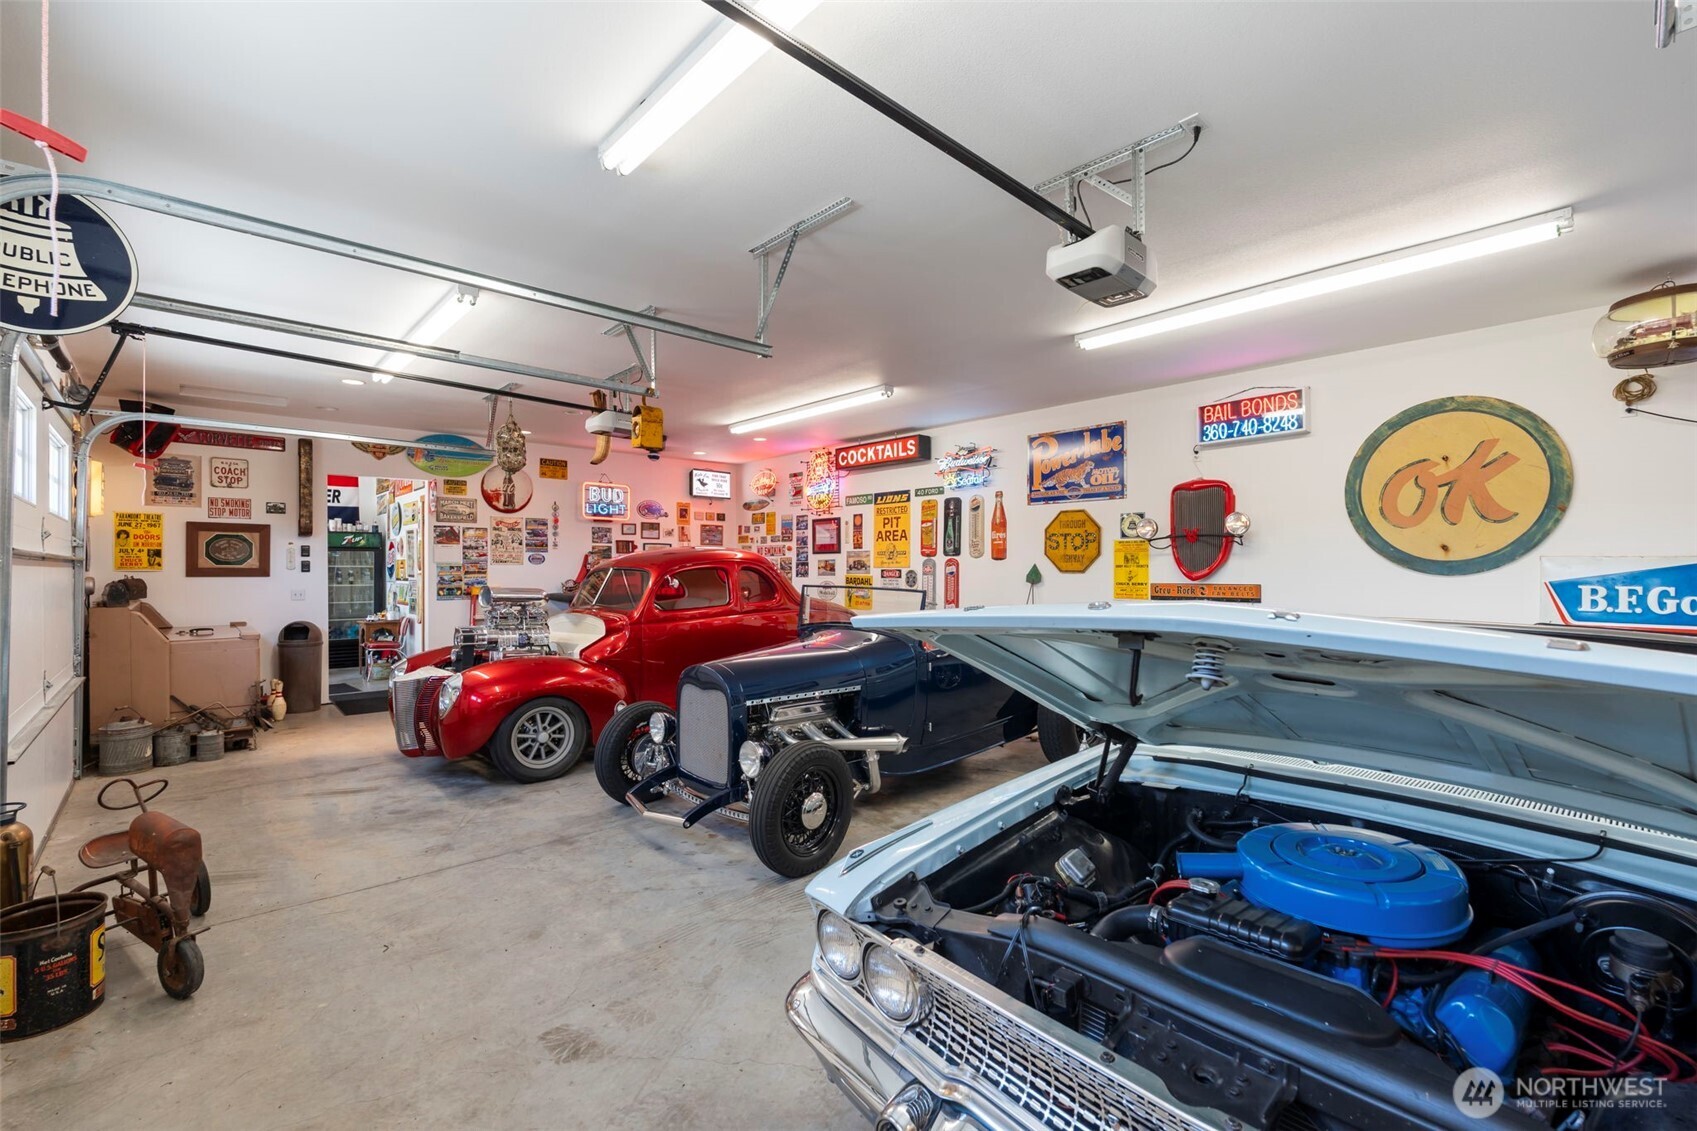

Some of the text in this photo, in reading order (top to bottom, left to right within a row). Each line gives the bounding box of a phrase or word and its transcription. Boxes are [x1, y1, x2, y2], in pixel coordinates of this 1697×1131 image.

[1203, 392, 1299, 424] BAIL BONDS
[1203, 415, 1298, 441] 360-740-8248
[838, 440, 916, 466] COCKTAILS
[213, 466, 247, 477] COACH
[217, 475, 243, 485] STOP
[1090, 473, 1119, 485] OIL
[1378, 438, 1521, 529] OK
[589, 486, 624, 503] BUD
[846, 496, 867, 505] FAMOSO
[876, 494, 909, 504] LIONS
[210, 499, 250, 508] NO SMOKING
[586, 503, 626, 515] LIGHT
[210, 508, 251, 517] STOP MOTOR
[876, 506, 908, 515] RESTRICTED
[882, 516, 902, 529] PIT
[1060, 520, 1086, 529] THROUGH
[876, 529, 908, 542] AREA
[1048, 530, 1097, 551] STOP
[845, 577, 873, 586] BARDAHL
